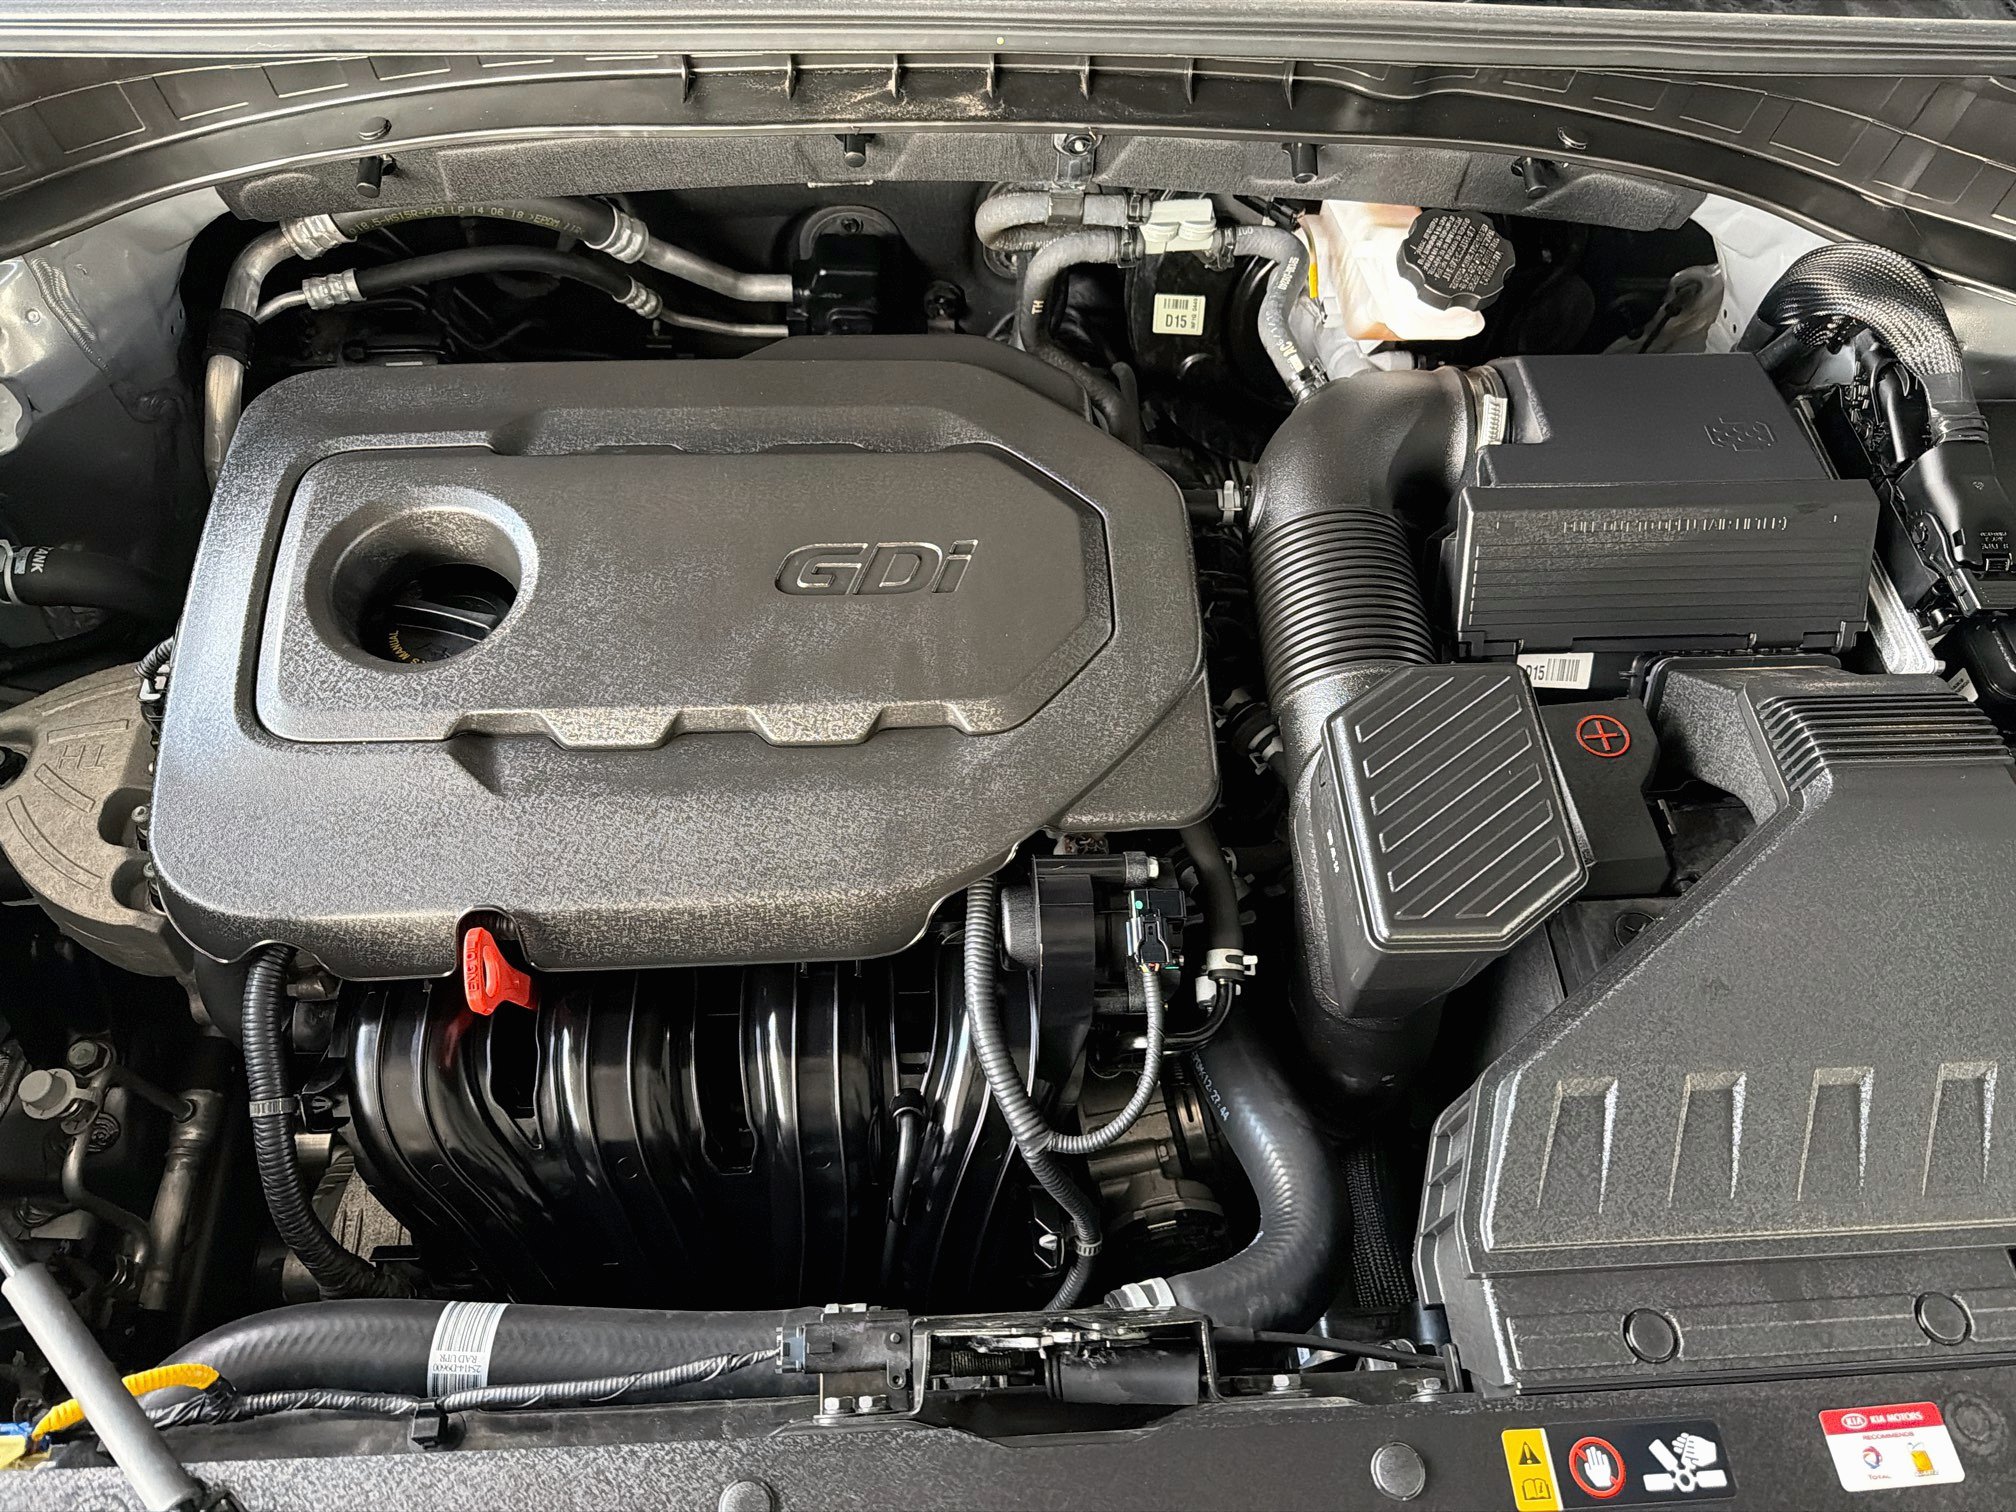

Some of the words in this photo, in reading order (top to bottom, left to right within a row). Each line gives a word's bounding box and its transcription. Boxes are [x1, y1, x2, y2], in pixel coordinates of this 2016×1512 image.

[1165, 313, 1187, 329] D15
[774, 539, 979, 596] GDi
[467, 964, 480, 993] ENG
[458, 1354, 478, 1364] RAD
[1844, 1415, 1864, 1427] KIA
[1869, 1414, 1886, 1424] KIA
[1886, 1411, 1923, 1423] MOTORS
